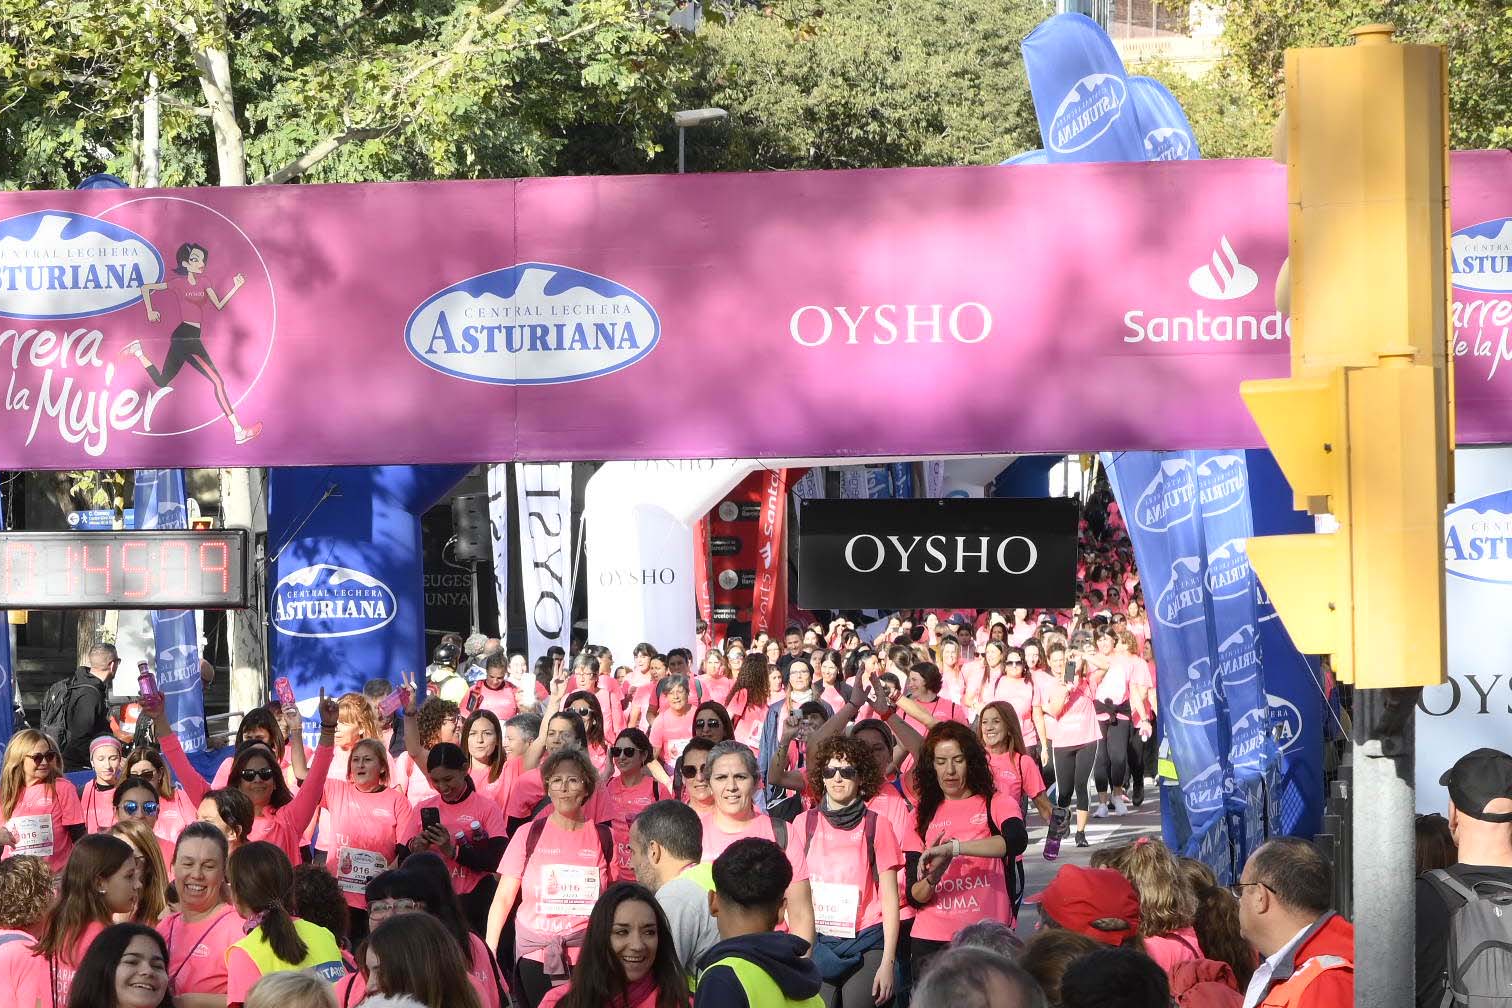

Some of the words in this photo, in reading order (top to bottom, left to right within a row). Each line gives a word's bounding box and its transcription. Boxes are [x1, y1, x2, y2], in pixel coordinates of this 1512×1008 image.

[66, 246, 140, 257] LECHERA
[464, 305, 542, 318] CENTRAL
[551, 303, 632, 316] LECHERA
[789, 301, 993, 346] OYSHO
[1123, 310, 1291, 344] Santand
[425, 310, 640, 354] ASTURIANA
[5, 371, 30, 412] la
[25, 363, 174, 457] Mujer
[845, 534, 1038, 575] OYSHO
[275, 594, 388, 621] ASTURIANA
[332, 588, 383, 598] LECHERA
[1416, 674, 1512, 716] OY
[353, 865, 370, 874] 016
